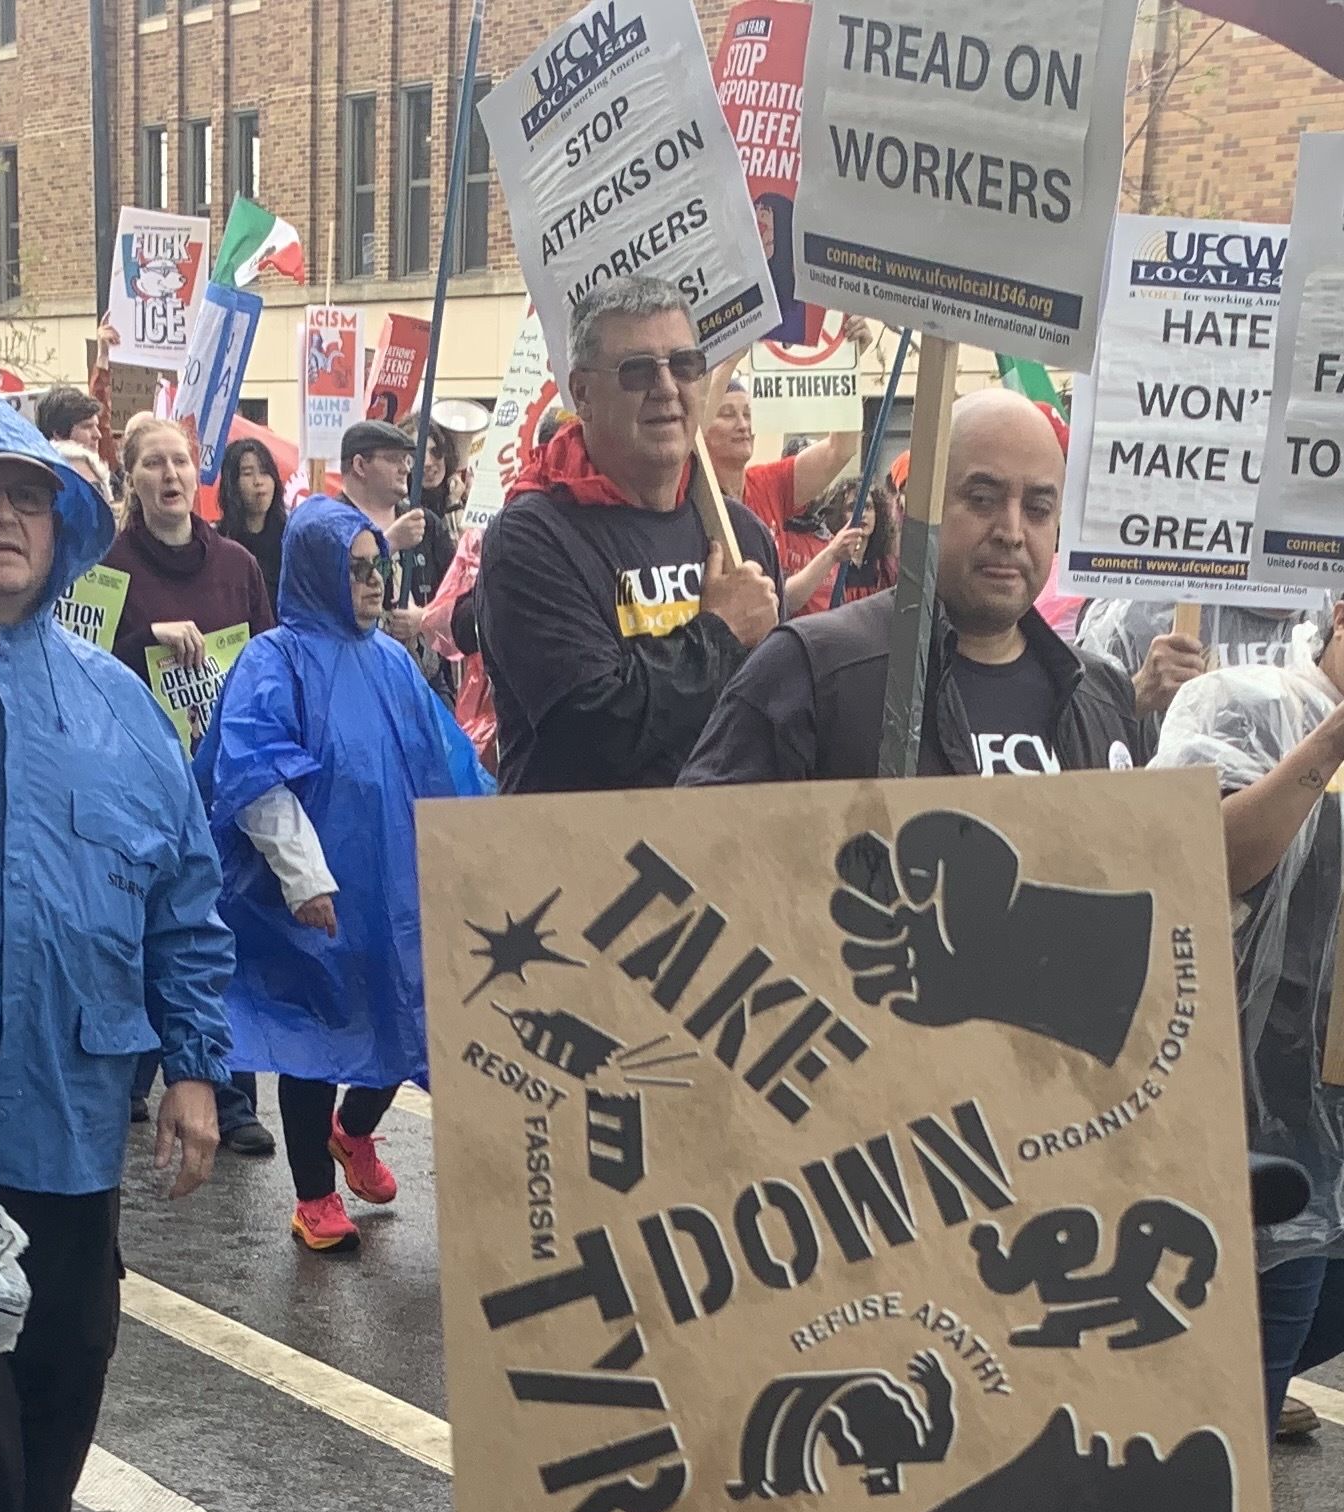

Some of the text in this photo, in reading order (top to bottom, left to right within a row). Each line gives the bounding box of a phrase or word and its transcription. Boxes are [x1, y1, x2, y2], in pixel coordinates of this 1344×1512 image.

[531, 2, 617, 96] UFCW
[723, 41, 768, 78] STOP
[839, 15, 1083, 110] TREAD ON
[525, 26, 639, 132] LOCAL 1546
[573, 75, 609, 110] working
[608, 44, 651, 80] America
[565, 95, 629, 168] STOP
[736, 109, 802, 148] DEFE
[539, 120, 705, 266] ATTACKS ON
[829, 124, 1072, 224] WORKERS
[130, 232, 192, 263] FUCK
[1165, 230, 1289, 270] UFCW
[826, 245, 1054, 318] connect: www.ufcwlocal1546.org
[1136, 263, 1283, 288] LOCAL 154
[134, 298, 187, 345] ICE
[809, 268, 1071, 346] United Food & Commercial Workers International Union
[1182, 290, 1202, 302] for
[1203, 292, 1253, 308] working
[1163, 308, 1273, 349] HATE
[752, 373, 857, 399] ARE THIEVES!
[1108, 440, 1261, 485] MAKE U
[1119, 513, 1254, 555] GREAT
[1286, 537, 1342, 555] connect:
[630, 562, 704, 607] UFC
[1072, 573, 1308, 595] United Food & Commercial Workers International Union
[1090, 555, 1143, 570] connect:
[1266, 556, 1297, 569] United
[1297, 559, 1320, 572] Food
[1321, 561, 1329, 572] &
[52, 600, 106, 628] ATION
[162, 656, 221, 692] DEFEND
[584, 838, 871, 1125] TAKE
[1017, 924, 1199, 1162] ORGANIZE TOGETHER
[461, 1038, 568, 1261] RESIST FASCISM
[639, 1098, 1018, 1326] DOWN
[789, 1290, 1015, 1397] REFUSE APATHY
